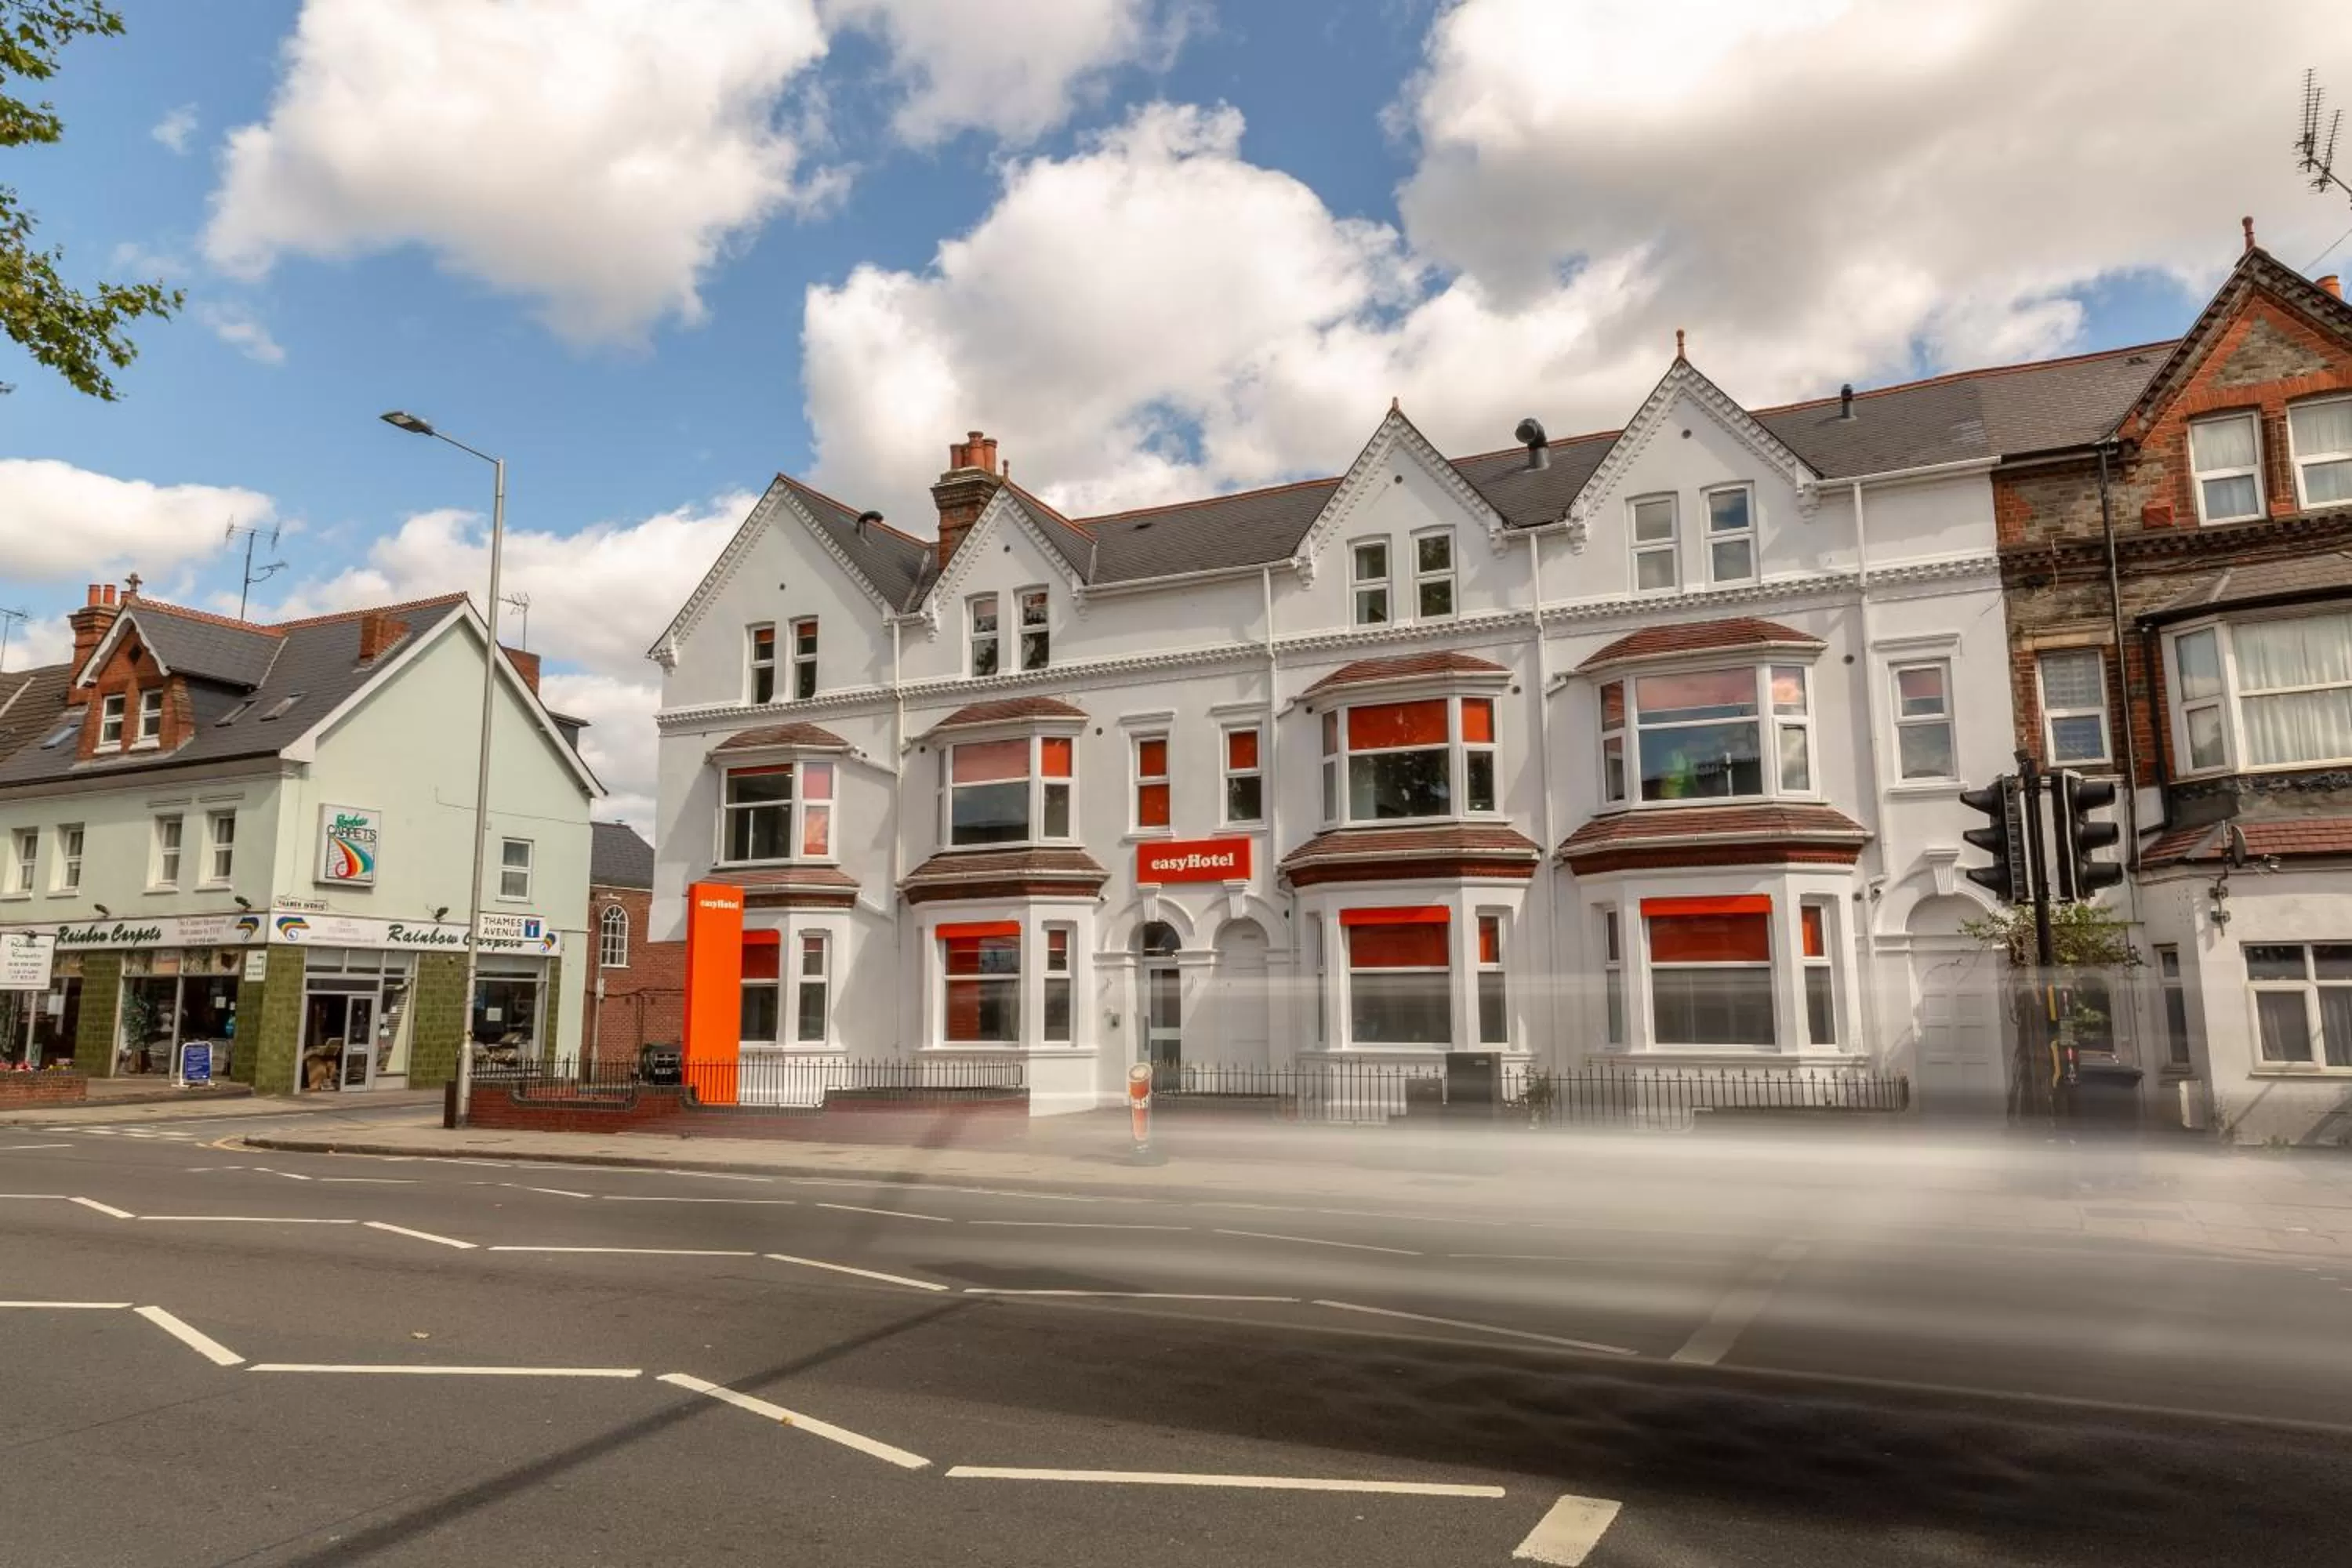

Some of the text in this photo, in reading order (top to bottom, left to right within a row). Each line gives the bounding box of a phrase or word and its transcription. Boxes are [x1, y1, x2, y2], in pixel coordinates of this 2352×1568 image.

[1151, 852, 1234, 871] easyHotel
[699, 899, 739, 910] easyHotel
[484, 916, 522, 927] THAMES
[58, 925, 108, 943] Rainbow
[111, 923, 162, 947] Carpets
[387, 923, 459, 943] Rainbow
[484, 927, 521, 937] AVENUE
